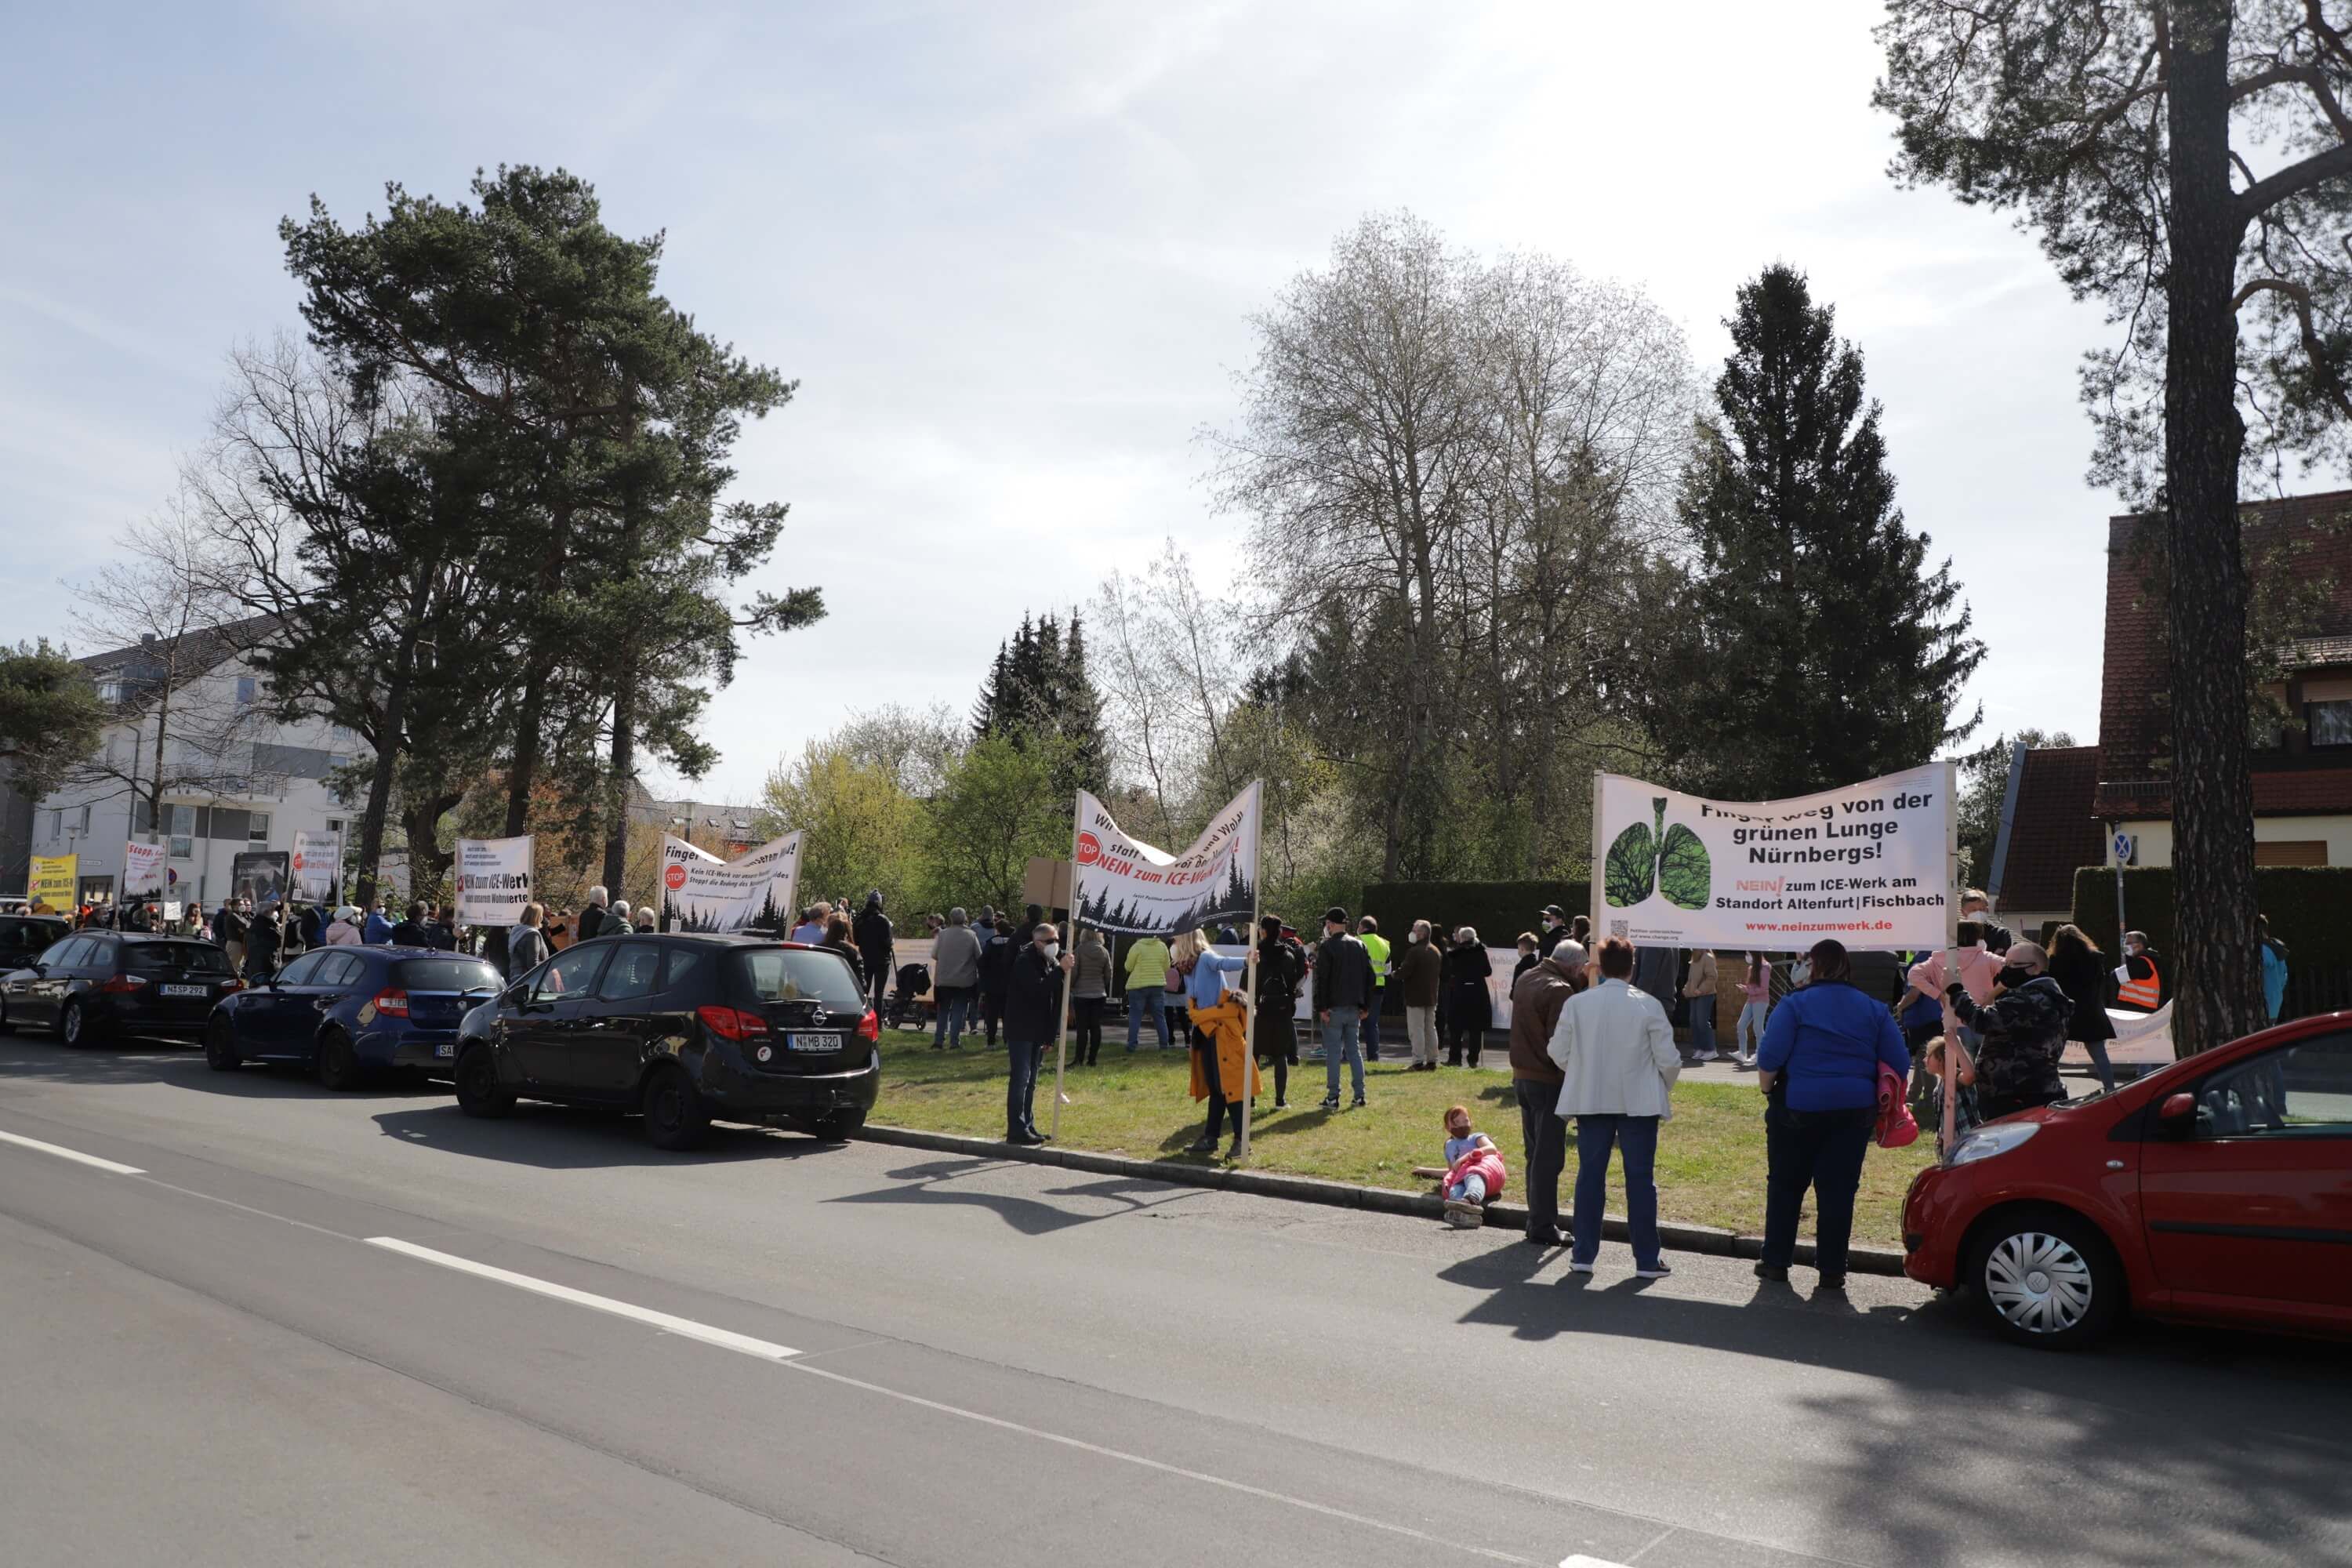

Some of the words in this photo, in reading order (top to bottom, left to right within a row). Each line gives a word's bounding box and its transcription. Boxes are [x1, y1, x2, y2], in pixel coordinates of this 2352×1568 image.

[1842, 799, 1885, 815] von
[1893, 792, 1933, 810] der
[1733, 824, 1817, 845] grünen
[1826, 820, 1899, 840] Lunge
[1078, 841, 1097, 855] TOP
[1748, 841, 1882, 865] Nürnbergs!
[691, 867, 705, 876] Kein
[706, 868, 731, 879] ICE-Werk
[1096, 853, 1134, 877] NEIN
[1133, 869, 1163, 884] zum
[666, 872, 684, 883] STOP
[689, 877, 708, 886] Stoppt
[1785, 880, 1816, 892] zum
[1820, 876, 1886, 891] ICE-Werk
[1892, 877, 1918, 888] am
[491, 893, 528, 904] Wohnvierte
[1715, 896, 1784, 910] Standort
[1744, 920, 1893, 932] www.neinzumwerk.de
[808, 1036, 820, 1047] MB
[822, 1036, 838, 1047] 320
